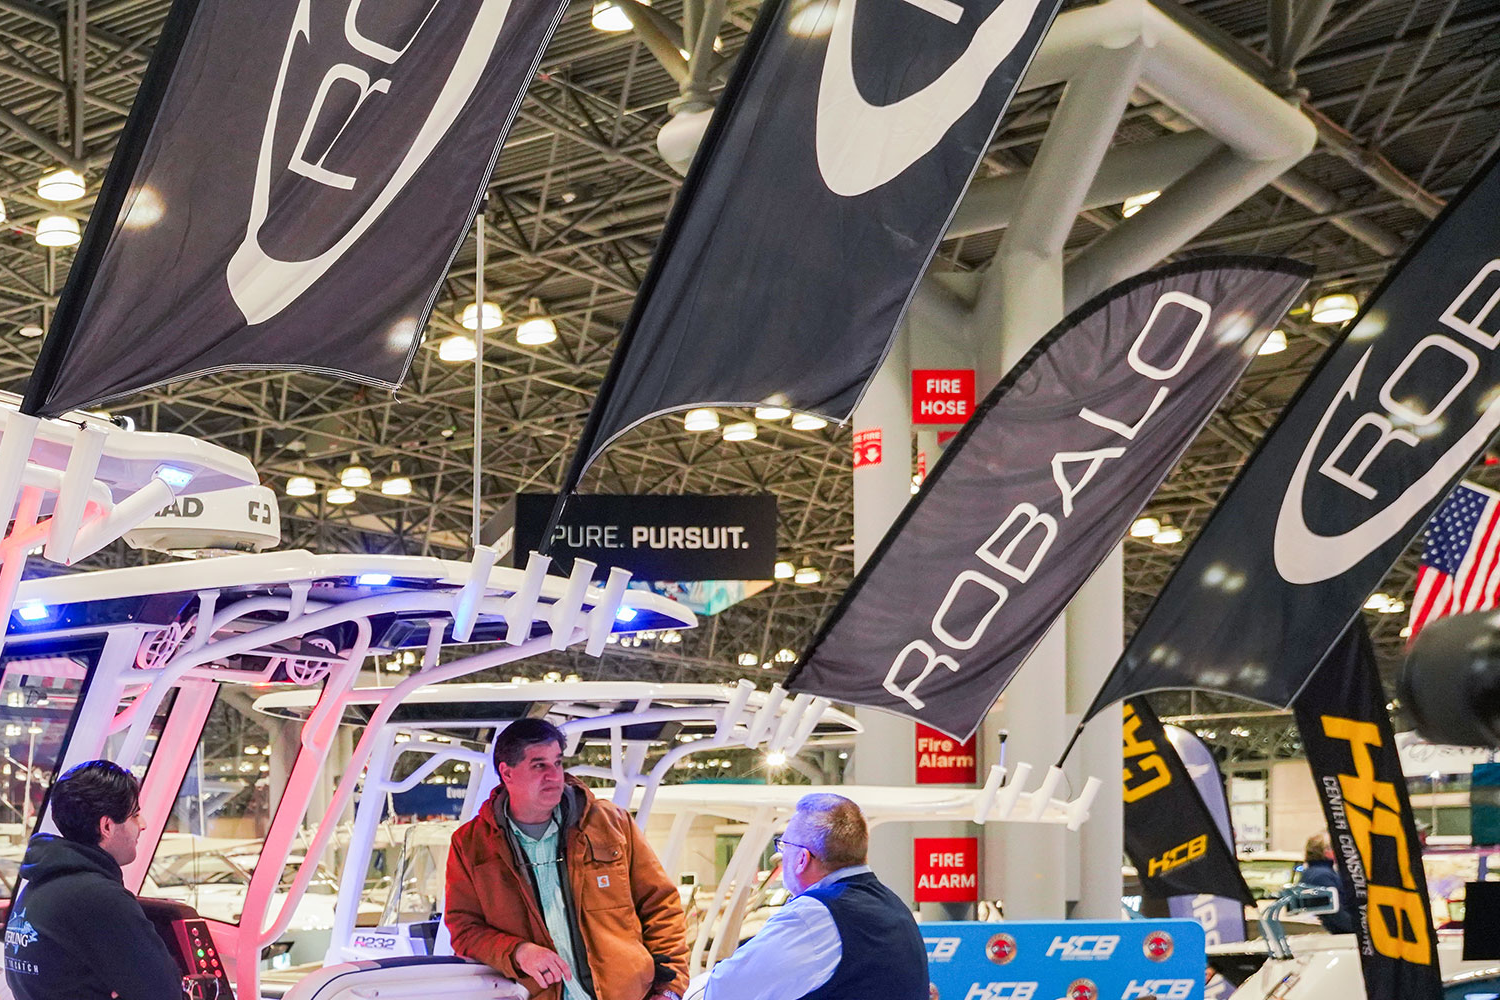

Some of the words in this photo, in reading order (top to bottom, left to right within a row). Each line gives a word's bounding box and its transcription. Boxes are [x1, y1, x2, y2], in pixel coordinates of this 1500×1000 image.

[925, 378, 961, 394] FIRE
[920, 400, 967, 415] HOSE
[882, 291, 1212, 710] ROBALO
[632, 526, 750, 549] PURSUIT.
[917, 737, 953, 752] Fire
[918, 752, 974, 768] Alarm
[1320, 714, 1432, 966] HCB
[1322, 775, 1344, 829] CENTER
[1338, 833, 1367, 899] CONSOLE
[929, 852, 964, 868] FIRE
[1147, 833, 1209, 878] HCB
[918, 873, 976, 888] ALARM
[353, 935, 396, 949] R232
